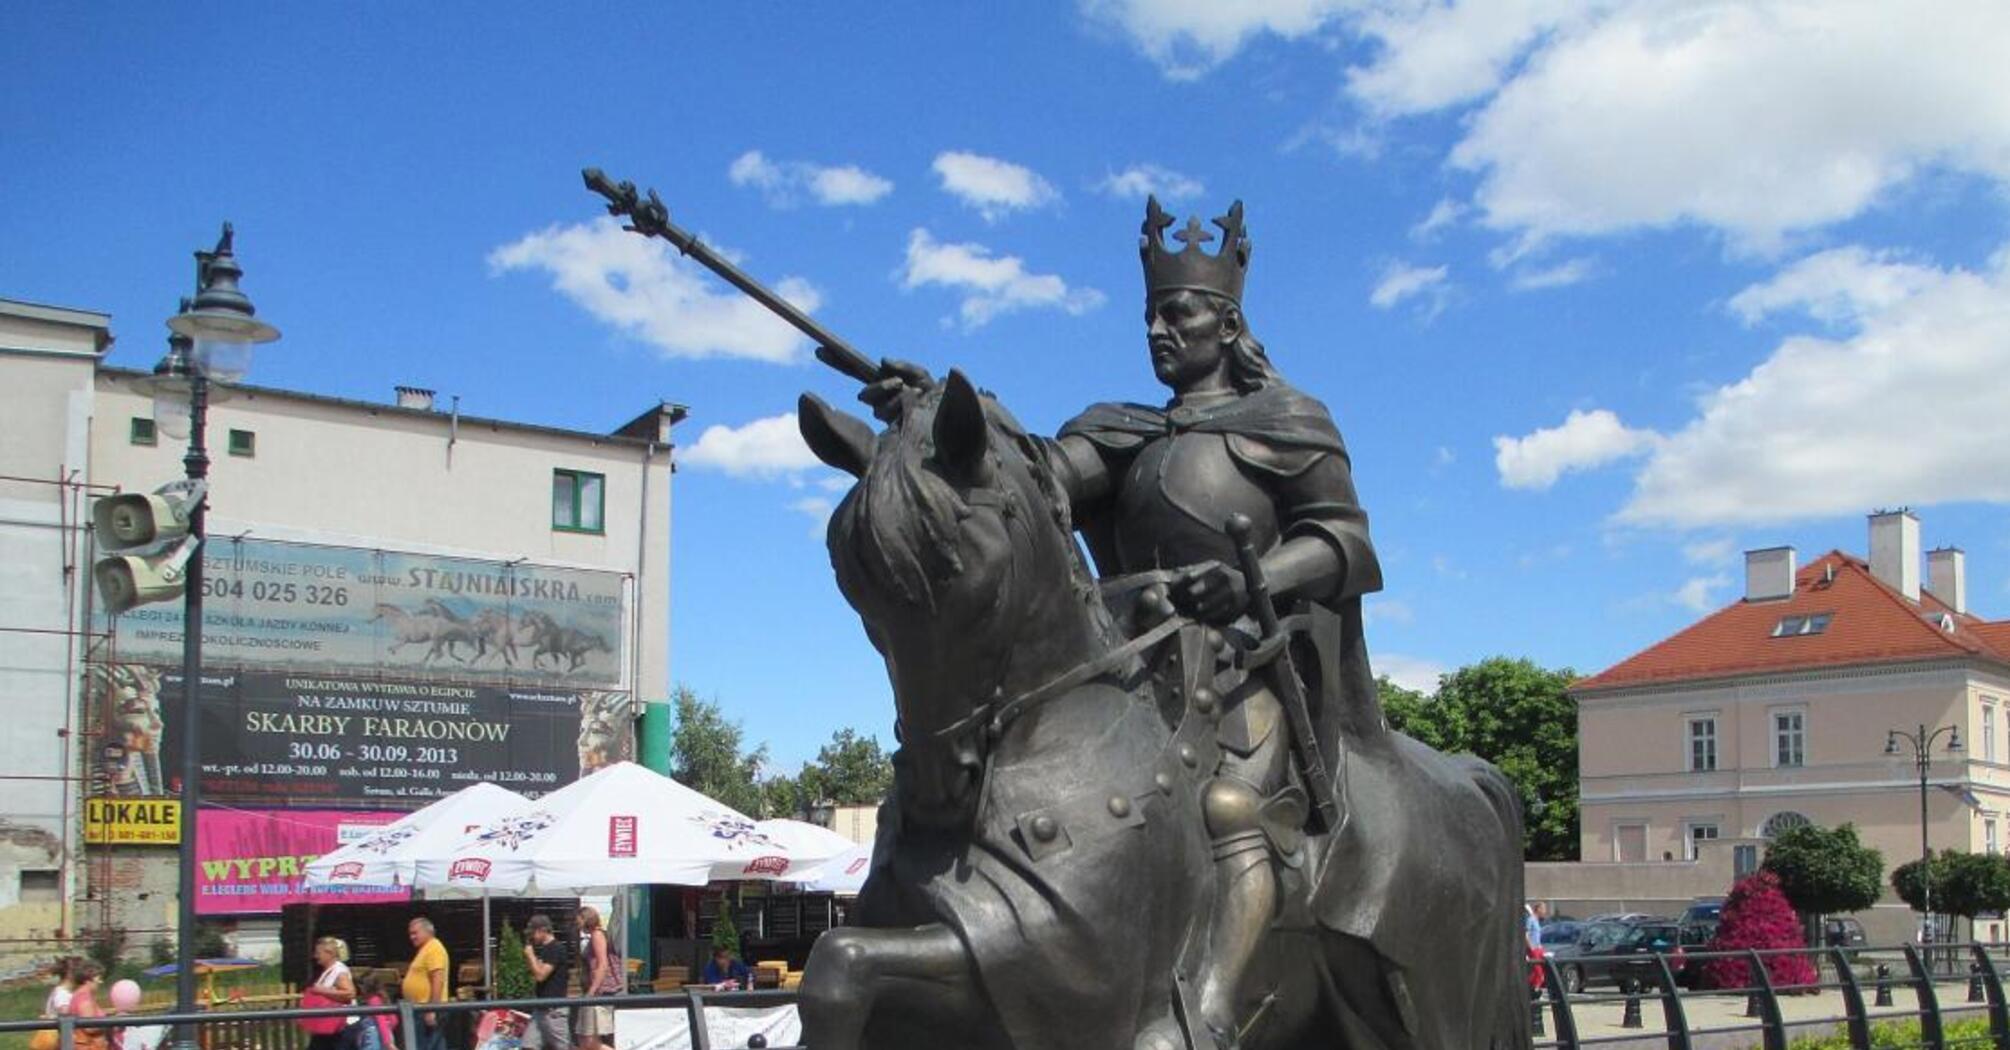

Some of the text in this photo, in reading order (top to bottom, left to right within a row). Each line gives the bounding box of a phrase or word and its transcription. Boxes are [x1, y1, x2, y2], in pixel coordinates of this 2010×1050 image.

[303, 564, 347, 580] POLE
[252, 581, 297, 603] 025
[305, 584, 349, 606] 326
[286, 678, 359, 692] UNIKATOWA
[418, 685, 429, 695] O
[298, 695, 321, 708] NA
[403, 701, 471, 715] SZTUMIE
[246, 711, 510, 742] SKARBY FARAONÓW
[289, 742, 341, 760] 30.06
[416, 747, 458, 763] 2013
[243, 763, 259, 774] od
[362, 767, 377, 778] od
[483, 770, 498, 781] od
[89, 803, 175, 825] LOKALE
